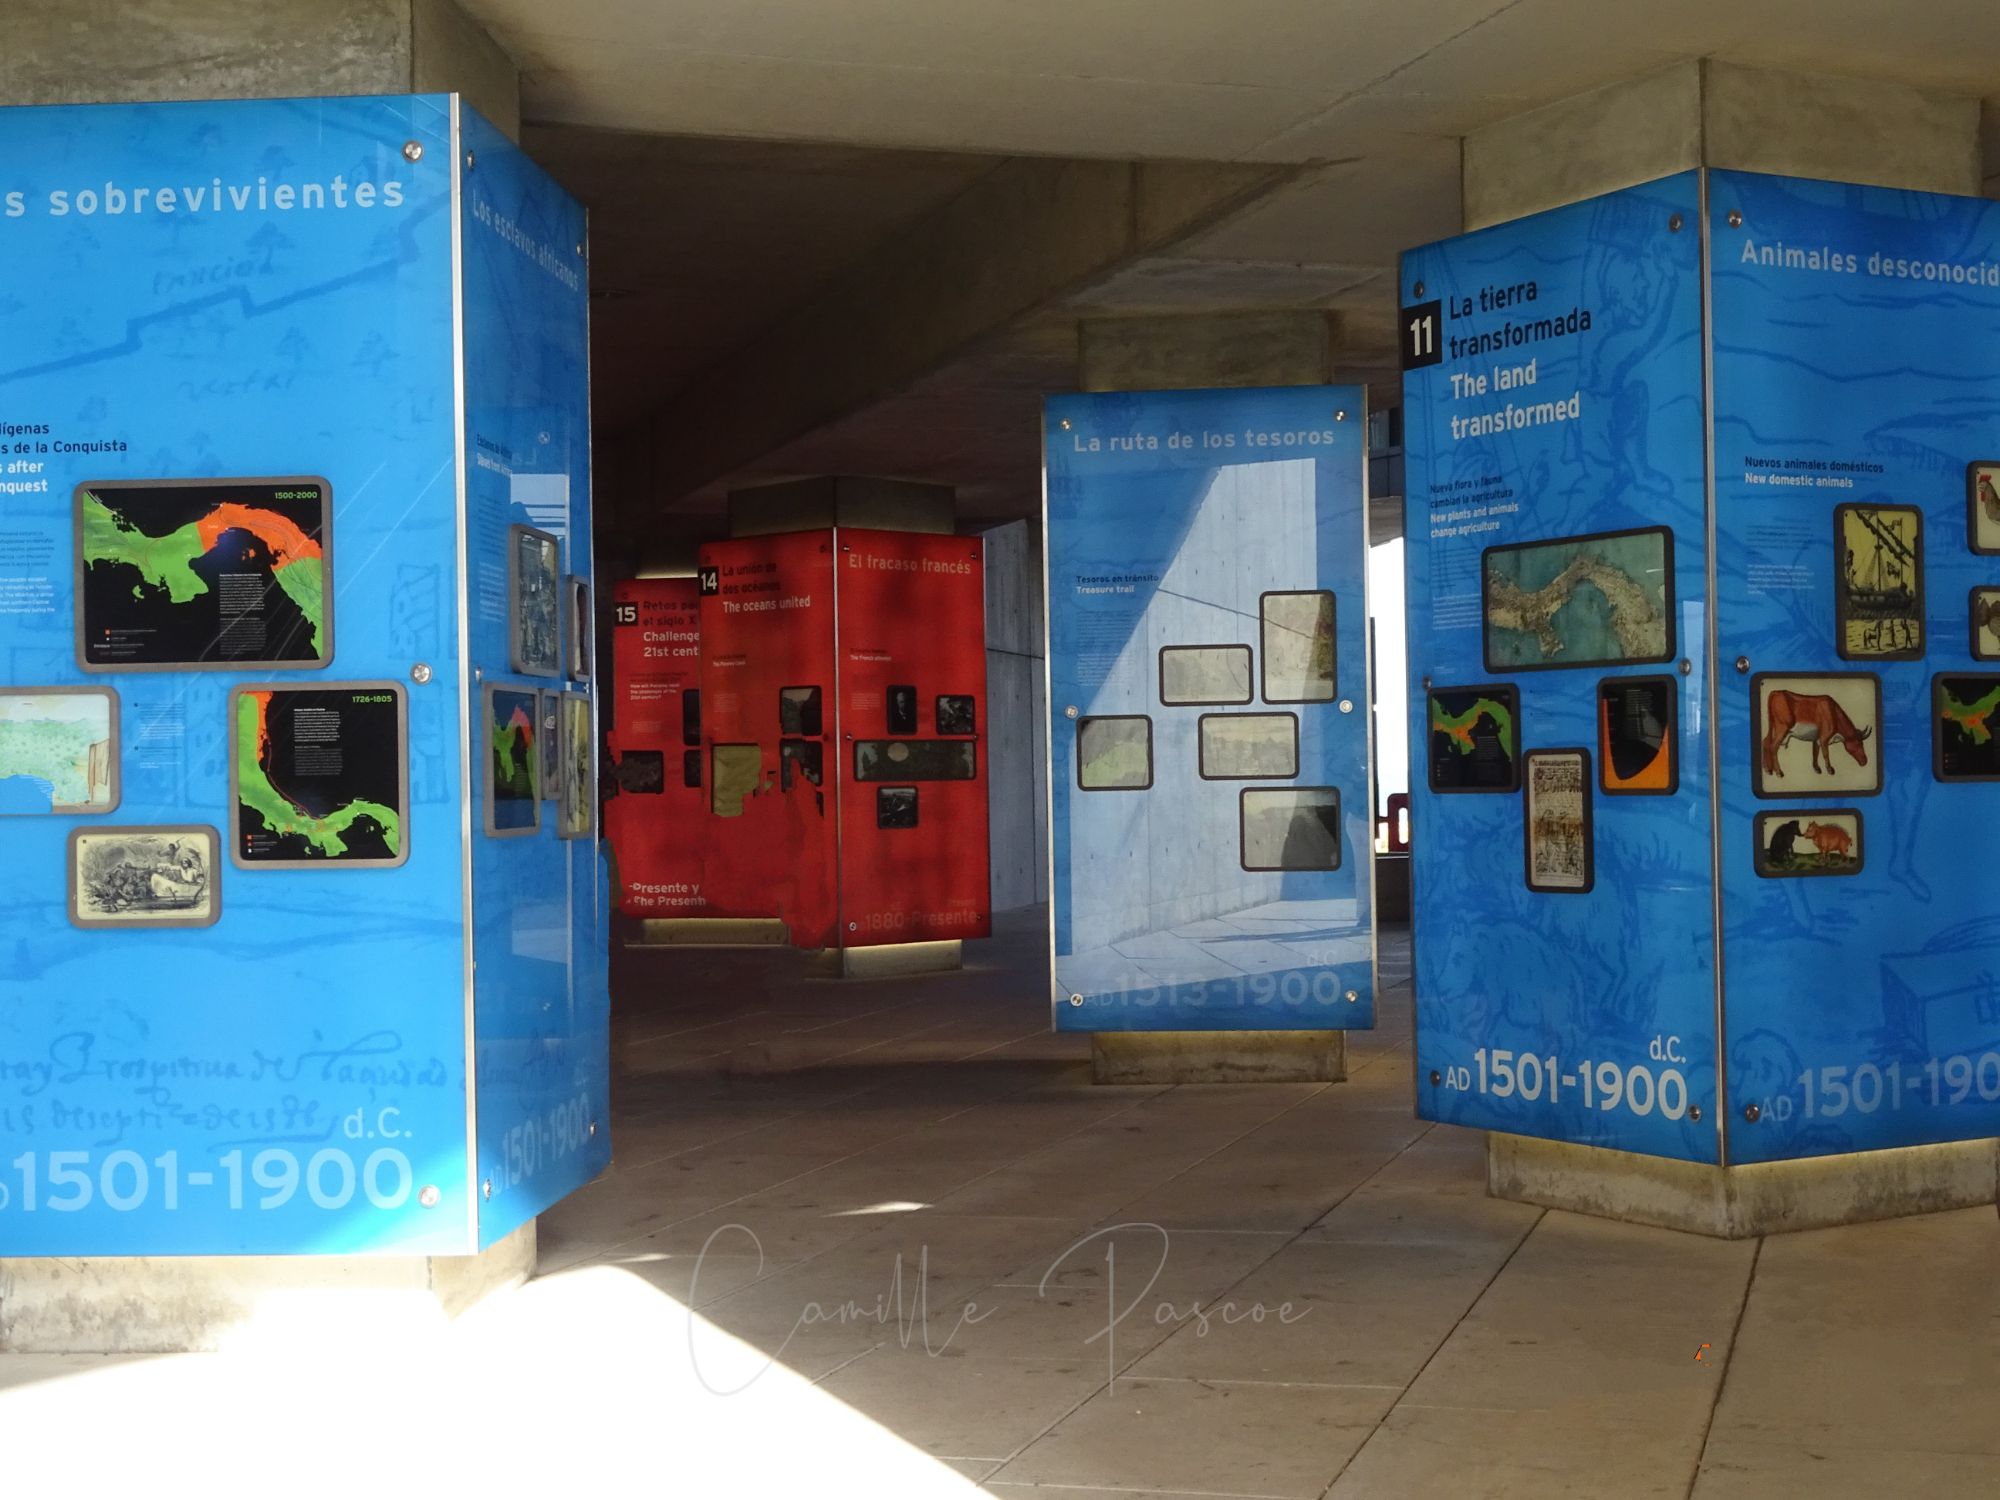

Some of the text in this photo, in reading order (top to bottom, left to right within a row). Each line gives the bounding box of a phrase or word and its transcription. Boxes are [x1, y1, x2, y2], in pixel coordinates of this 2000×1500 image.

[6, 175, 404, 217] s sobrevivientes
[473, 189, 491, 226] Los
[494, 211, 535, 260] esclavos
[1741, 239, 1999, 287] Animales desconocid
[1450, 280, 1537, 320] La tierra
[1410, 315, 1432, 357] 11
[1450, 307, 1591, 360] transformada
[1451, 358, 1537, 400] The land
[1451, 391, 1581, 440] transformed
[0, 421, 49, 437] ígenas
[14, 442, 30, 454] de
[36, 441, 48, 453] la
[53, 439, 127, 454] Conquista
[1074, 428, 1334, 452] La ruta de los tesoros
[8, 460, 43, 473] after
[1745, 456, 1884, 473] Nuevos animales domésticos
[1430, 483, 1453, 494] Nueva
[1473, 479, 1479, 489] y
[1745, 473, 1853, 488] New domestic animals
[275, 491, 317, 500] 1500-2000
[1430, 487, 1513, 509] cambian la agricultura
[1430, 501, 1519, 524] New plants and animals
[1430, 520, 1500, 539] change agriculture
[723, 564, 734, 576] La
[849, 554, 971, 574] El fracaso francés
[701, 572, 718, 590] 14
[1076, 575, 1109, 583] Tesoros
[1125, 574, 1159, 583] tránsito
[1076, 585, 1135, 594] Treasure trail
[616, 606, 636, 622] 15
[723, 595, 811, 614] The oceans united
[657, 617, 684, 627] siglo
[643, 631, 700, 643] Challenge
[643, 646, 669, 657] 21st
[672, 646, 699, 657] cent
[352, 695, 392, 703] 1726-1805
[1649, 1034, 1687, 1064] d.C.
[1445, 1047, 1688, 1121] AD 1501-1900
[1759, 1052, 2000, 1122] AD 1501-190
[344, 1106, 412, 1139] d.C.
[13, 1147, 413, 1212] 1501-1900
